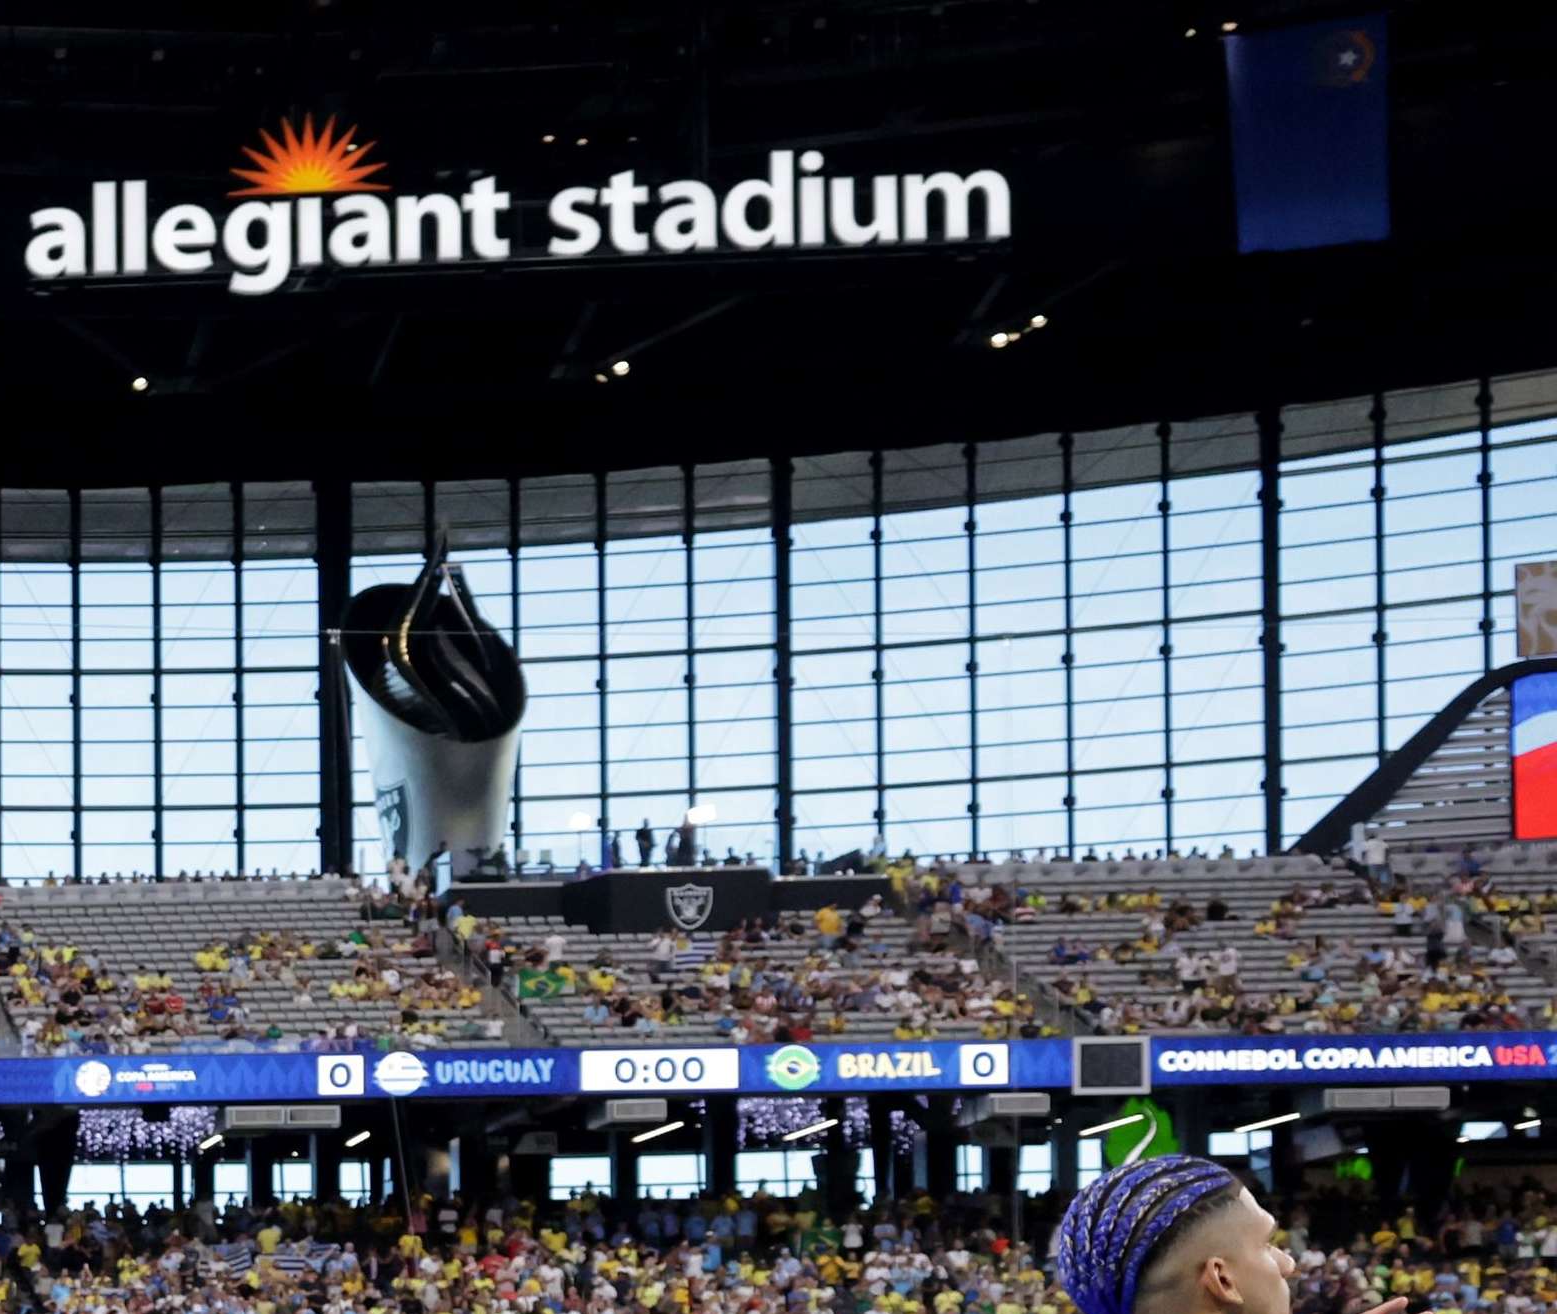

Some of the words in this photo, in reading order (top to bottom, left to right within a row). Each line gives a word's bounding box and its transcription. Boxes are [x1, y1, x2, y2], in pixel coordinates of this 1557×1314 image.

[23, 176, 510, 295] allegiant
[547, 150, 1011, 256] stadium
[436, 1058, 554, 1085] URUGUAY
[614, 1056, 705, 1083] 0:00
[837, 1052, 942, 1079] BRAZIL
[972, 1052, 995, 1077] 0
[1158, 1049, 1302, 1073] CONMEBOL
[1303, 1047, 1374, 1070] COPA
[1373, 1045, 1493, 1070] AMERICA
[1494, 1043, 1547, 1067] USA
[329, 1063, 352, 1088] 0
